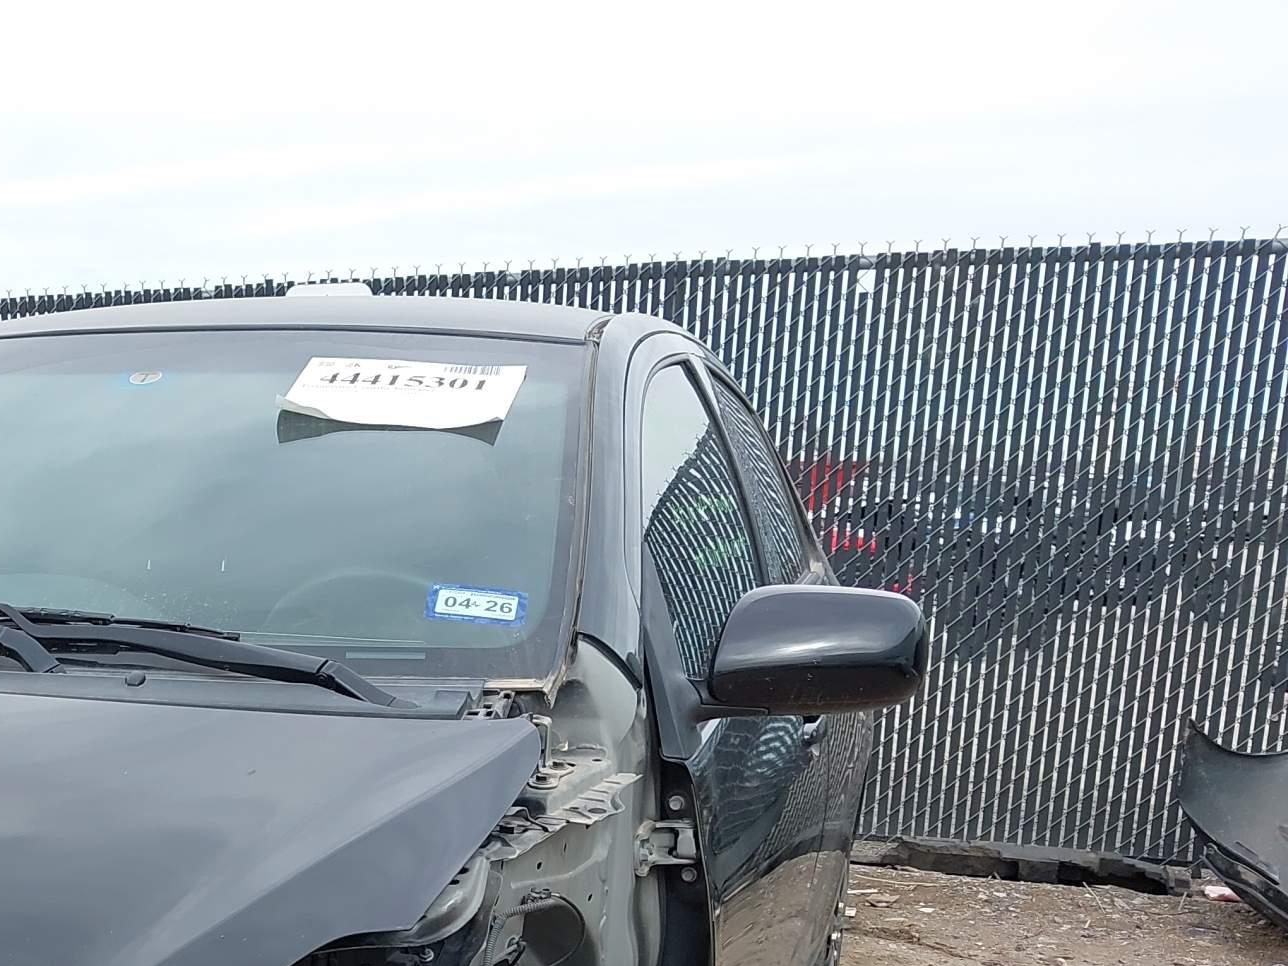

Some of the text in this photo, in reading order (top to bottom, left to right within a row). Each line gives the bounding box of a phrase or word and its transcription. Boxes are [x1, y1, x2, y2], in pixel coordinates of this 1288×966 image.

[319, 371, 488, 391] 44415301
[444, 596, 513, 614] 04 26
